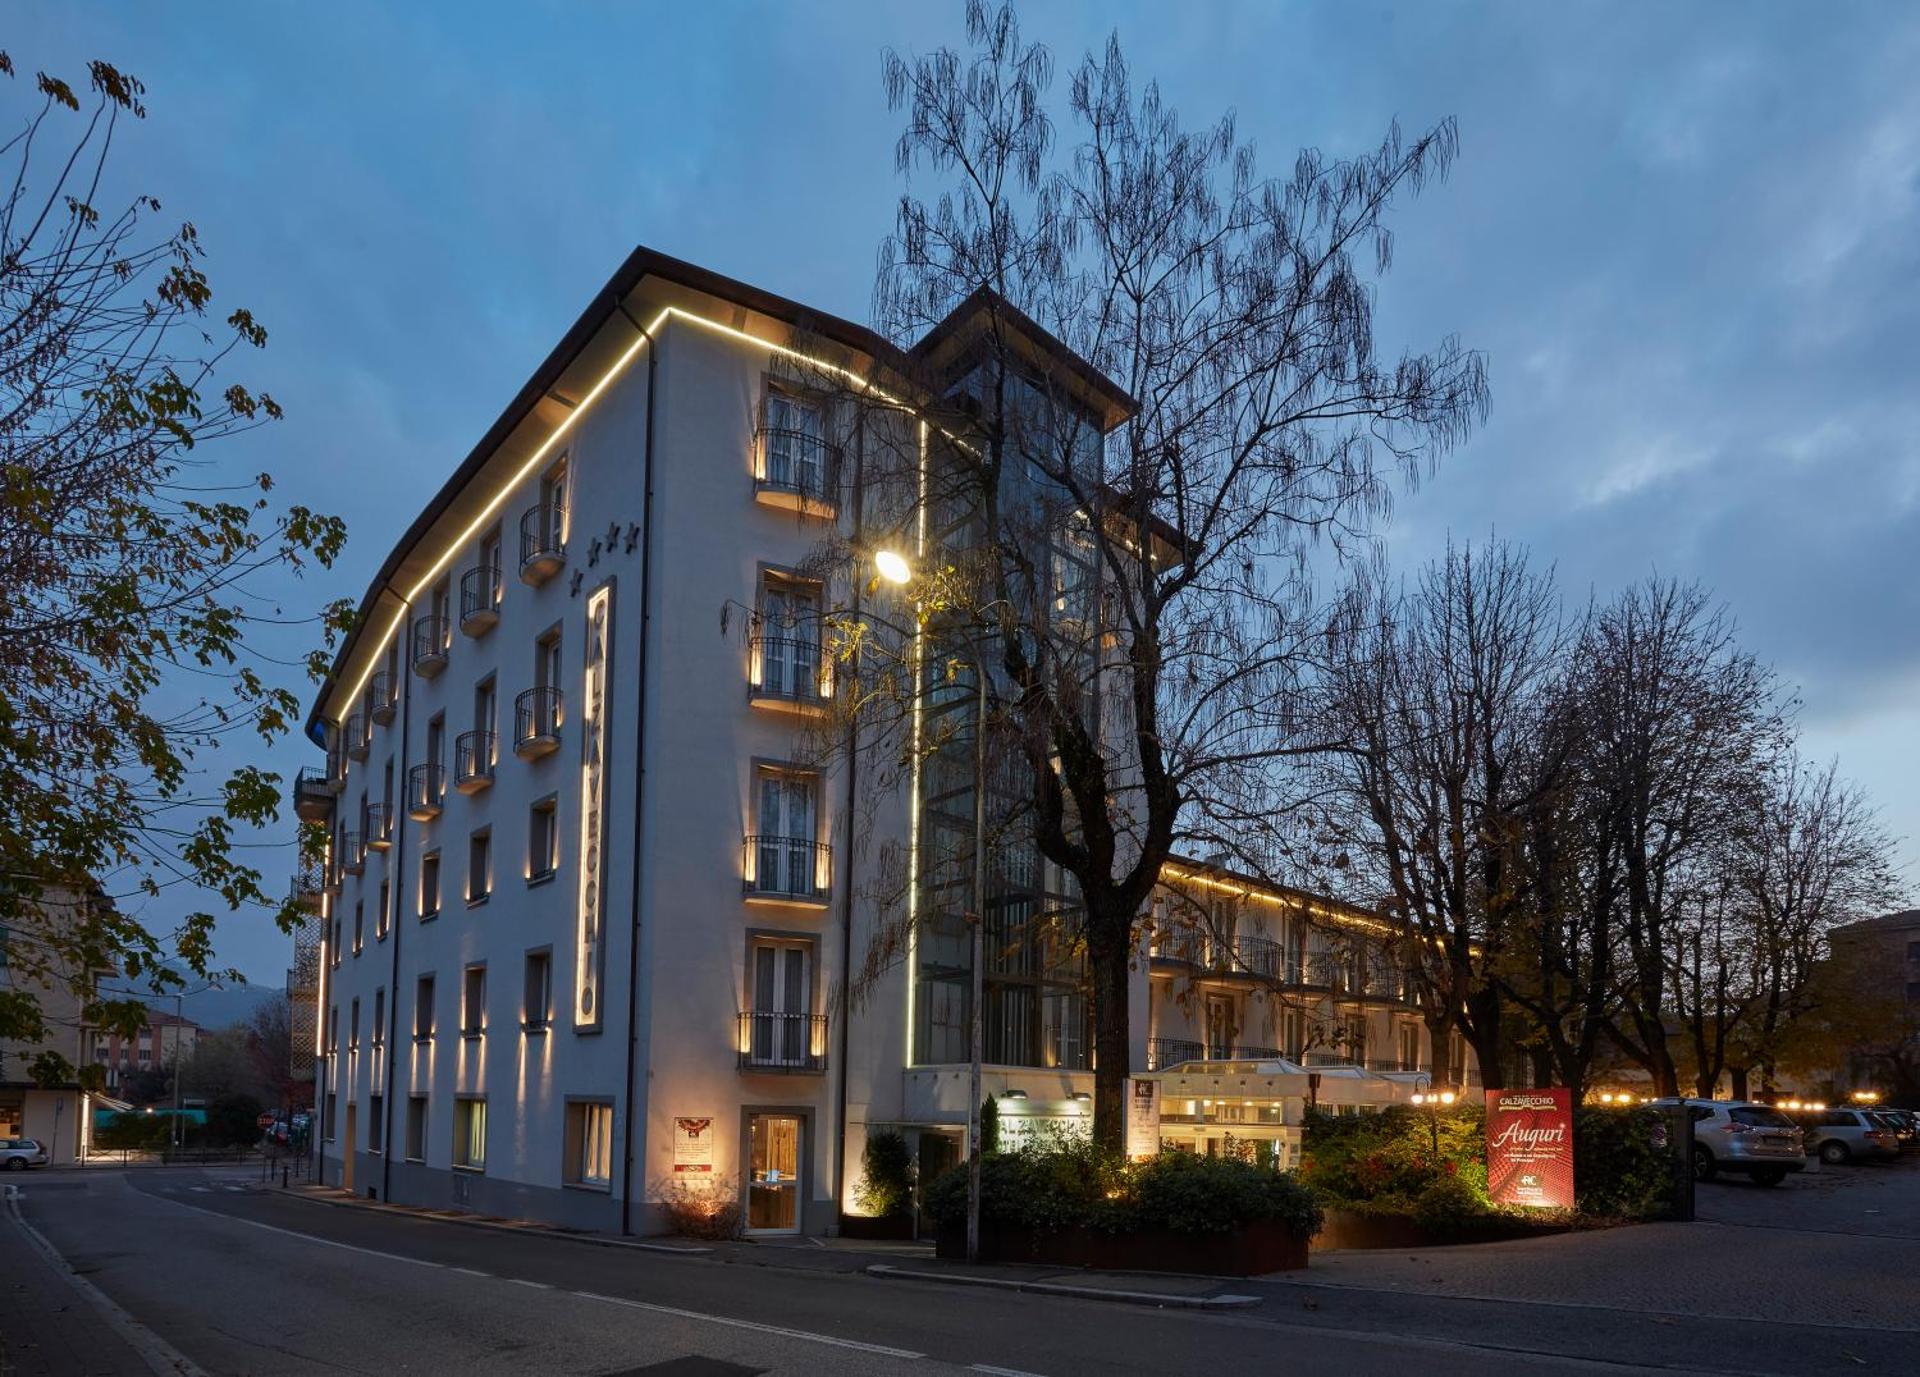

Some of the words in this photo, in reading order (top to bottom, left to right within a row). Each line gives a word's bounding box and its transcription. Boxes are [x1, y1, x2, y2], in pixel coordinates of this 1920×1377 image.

[582, 598, 606, 1016] CALZAVECCHIO
[1499, 1097, 1555, 1106] CALZAVECCHIO
[1492, 1119, 1566, 1151] Auguri
